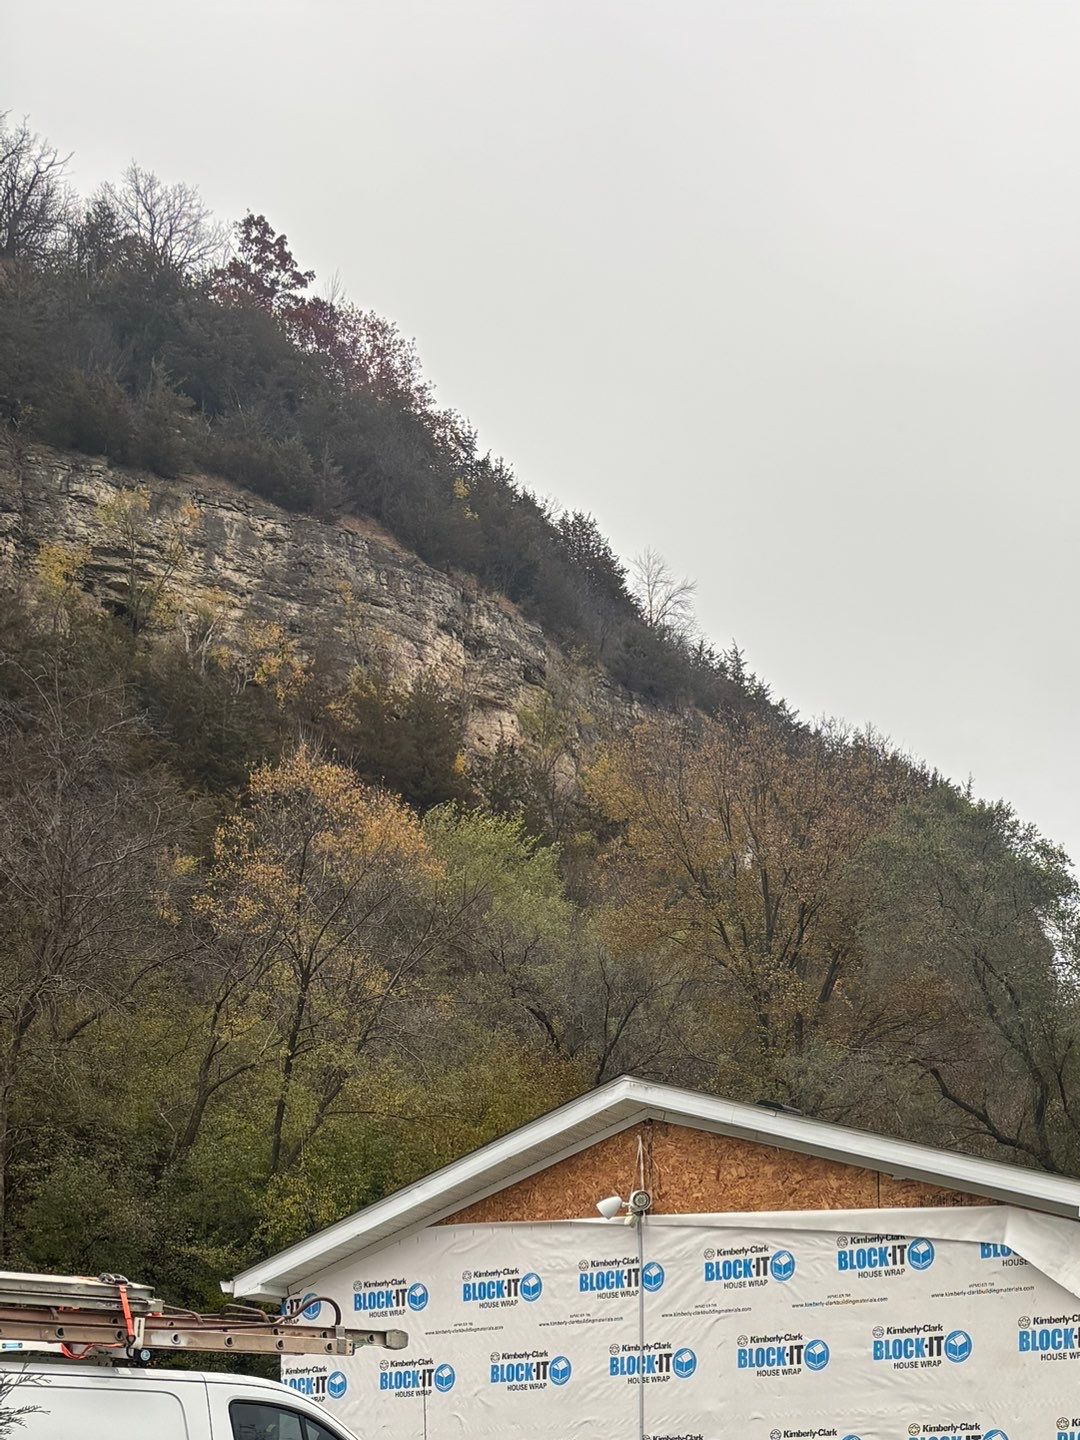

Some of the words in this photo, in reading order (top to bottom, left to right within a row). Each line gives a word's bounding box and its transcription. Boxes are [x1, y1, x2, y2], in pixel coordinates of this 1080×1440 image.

[858, 1270, 883, 1279] HOUSE
[884, 1268, 905, 1277] WRAP
[724, 1280, 746, 1289] HOUSE
[747, 1278, 768, 1288] WRAP
[597, 1291, 617, 1300] HOUSE
[618, 1290, 639, 1298] WRAP
[479, 1300, 499, 1309] HOUSE
[500, 1298, 518, 1307] WRAP
[1040, 1352, 1068, 1361] HOUSE
[894, 1360, 919, 1369] HOUSE
[920, 1359, 942, 1368] WRAP
[756, 1369, 780, 1378] HOUSE
[781, 1368, 801, 1376] WRAP
[507, 1382, 528, 1391] HOUSE
[528, 1381, 547, 1390] WRAP
